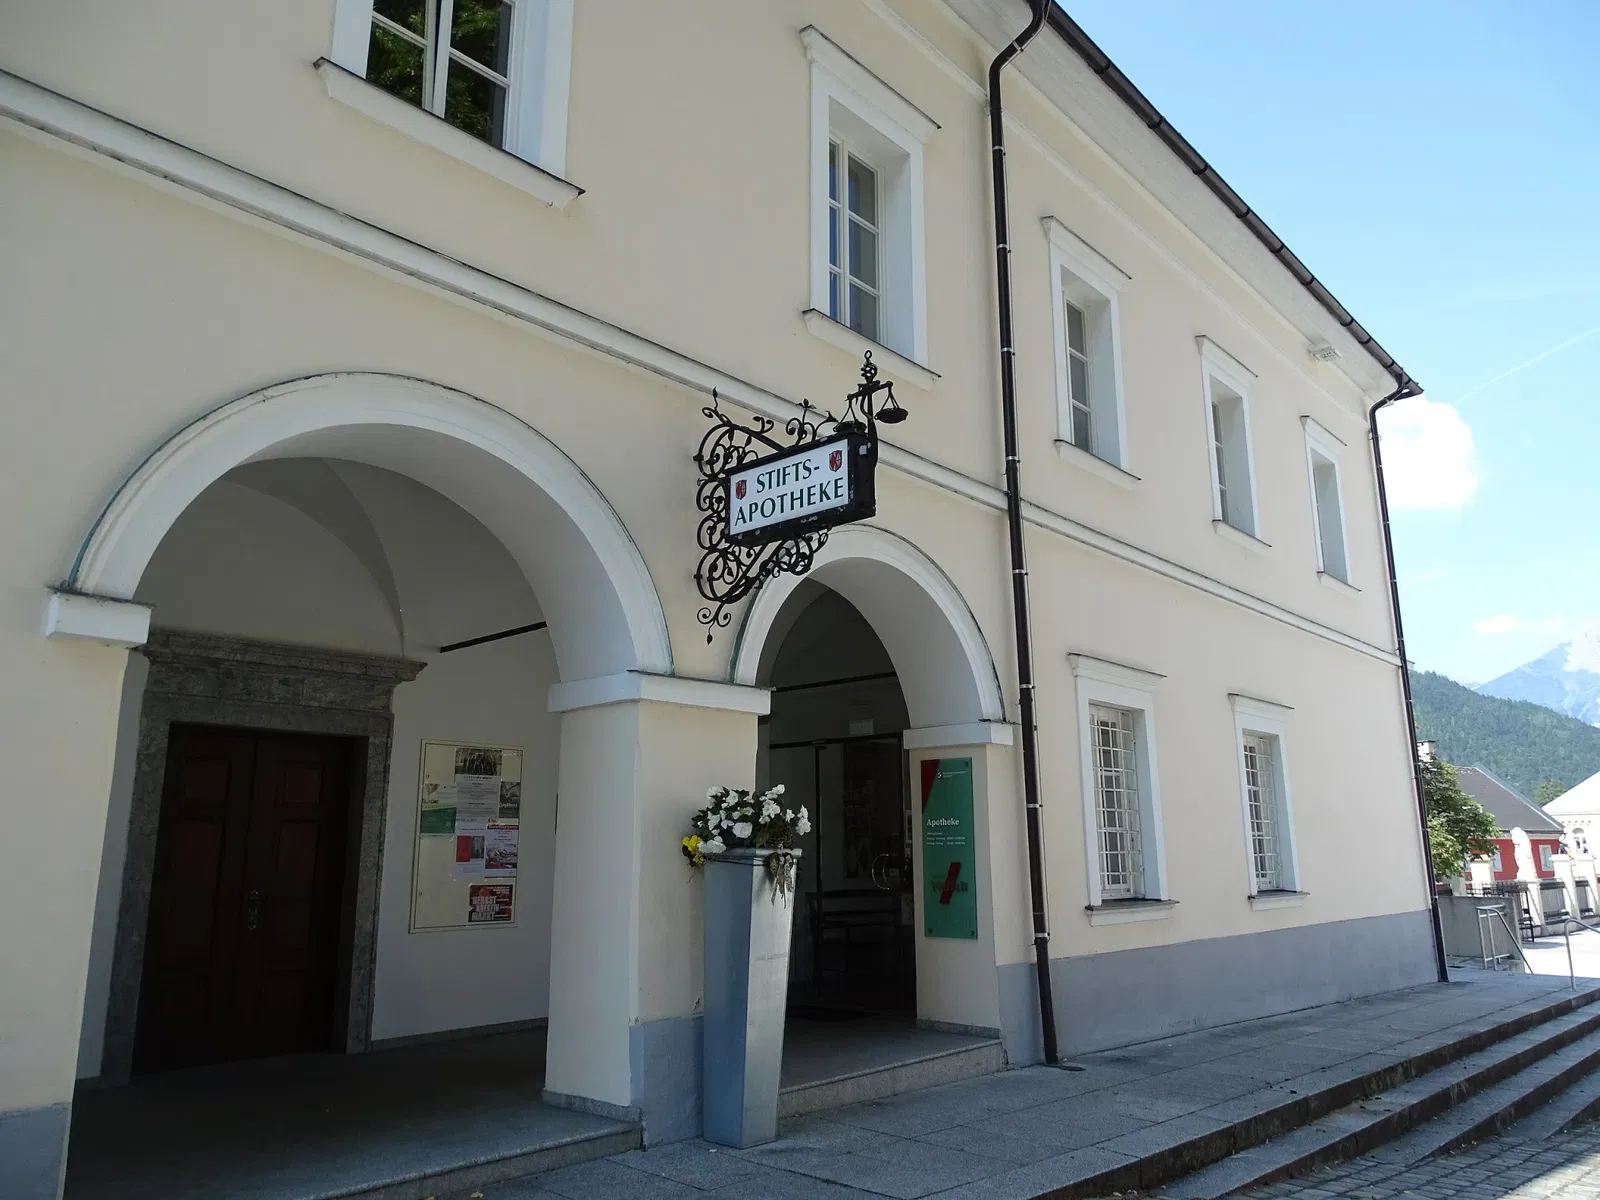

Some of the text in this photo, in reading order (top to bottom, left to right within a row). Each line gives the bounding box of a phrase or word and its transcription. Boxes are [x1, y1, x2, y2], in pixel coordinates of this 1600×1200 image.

[756, 458, 820, 493] STIFTS-
[734, 476, 844, 526] APOTHEKE
[926, 817, 960, 828] Apotheke
